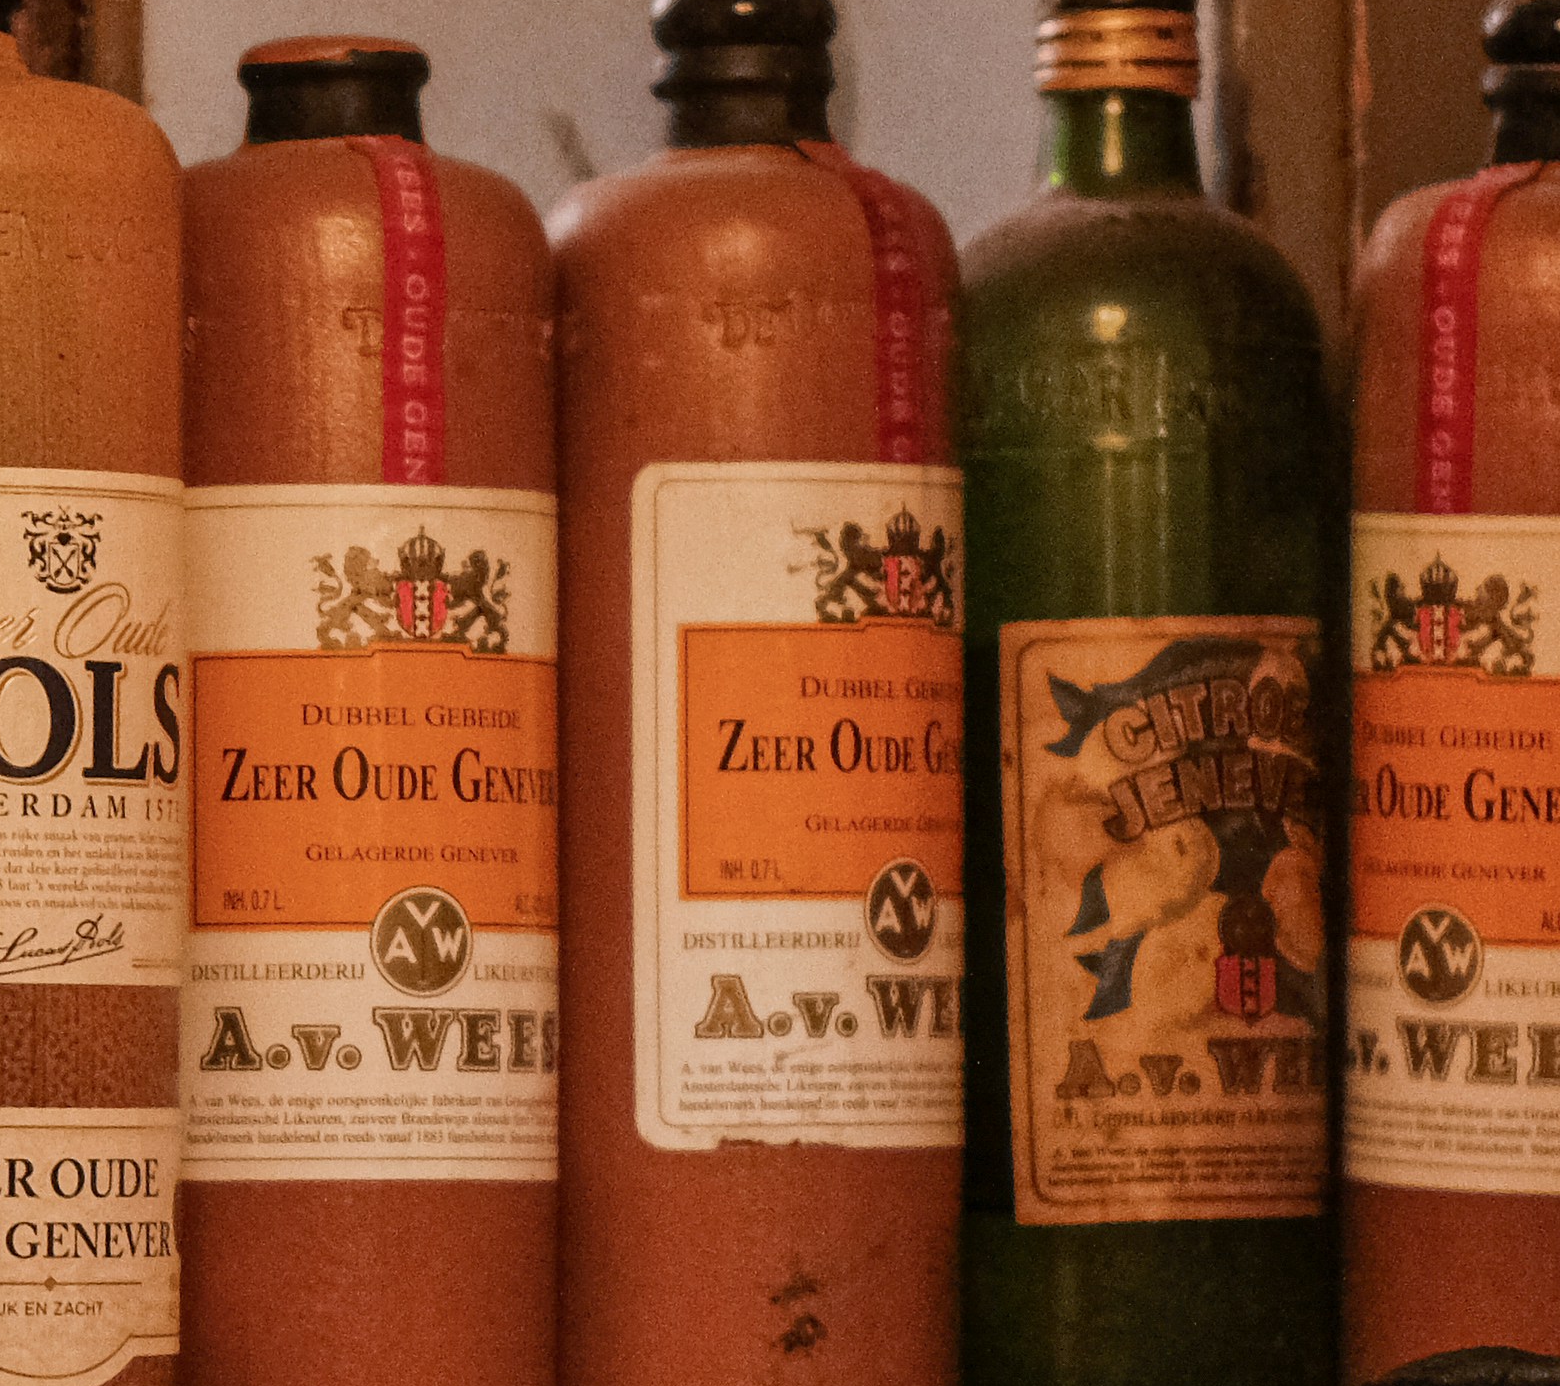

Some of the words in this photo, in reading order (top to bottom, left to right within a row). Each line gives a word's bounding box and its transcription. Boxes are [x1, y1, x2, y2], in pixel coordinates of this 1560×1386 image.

[402, 272, 429, 387] OUDE
[301, 702, 416, 727] DUBBEL
[717, 718, 817, 774] ZEER
[830, 717, 916, 774] OUDE
[221, 746, 319, 803] ZEER
[332, 746, 439, 803] OUDE
[1376, 763, 1450, 822] OUDE
[305, 843, 435, 863] GELAGERDE
[190, 962, 366, 982] DISTILLEERDERIJ
[49, 1156, 161, 1200] OUDE
[4, 1219, 172, 1261] GENEVER
[24, 1300, 48, 1317] EN
[52, 1299, 104, 1317] ZACHT
